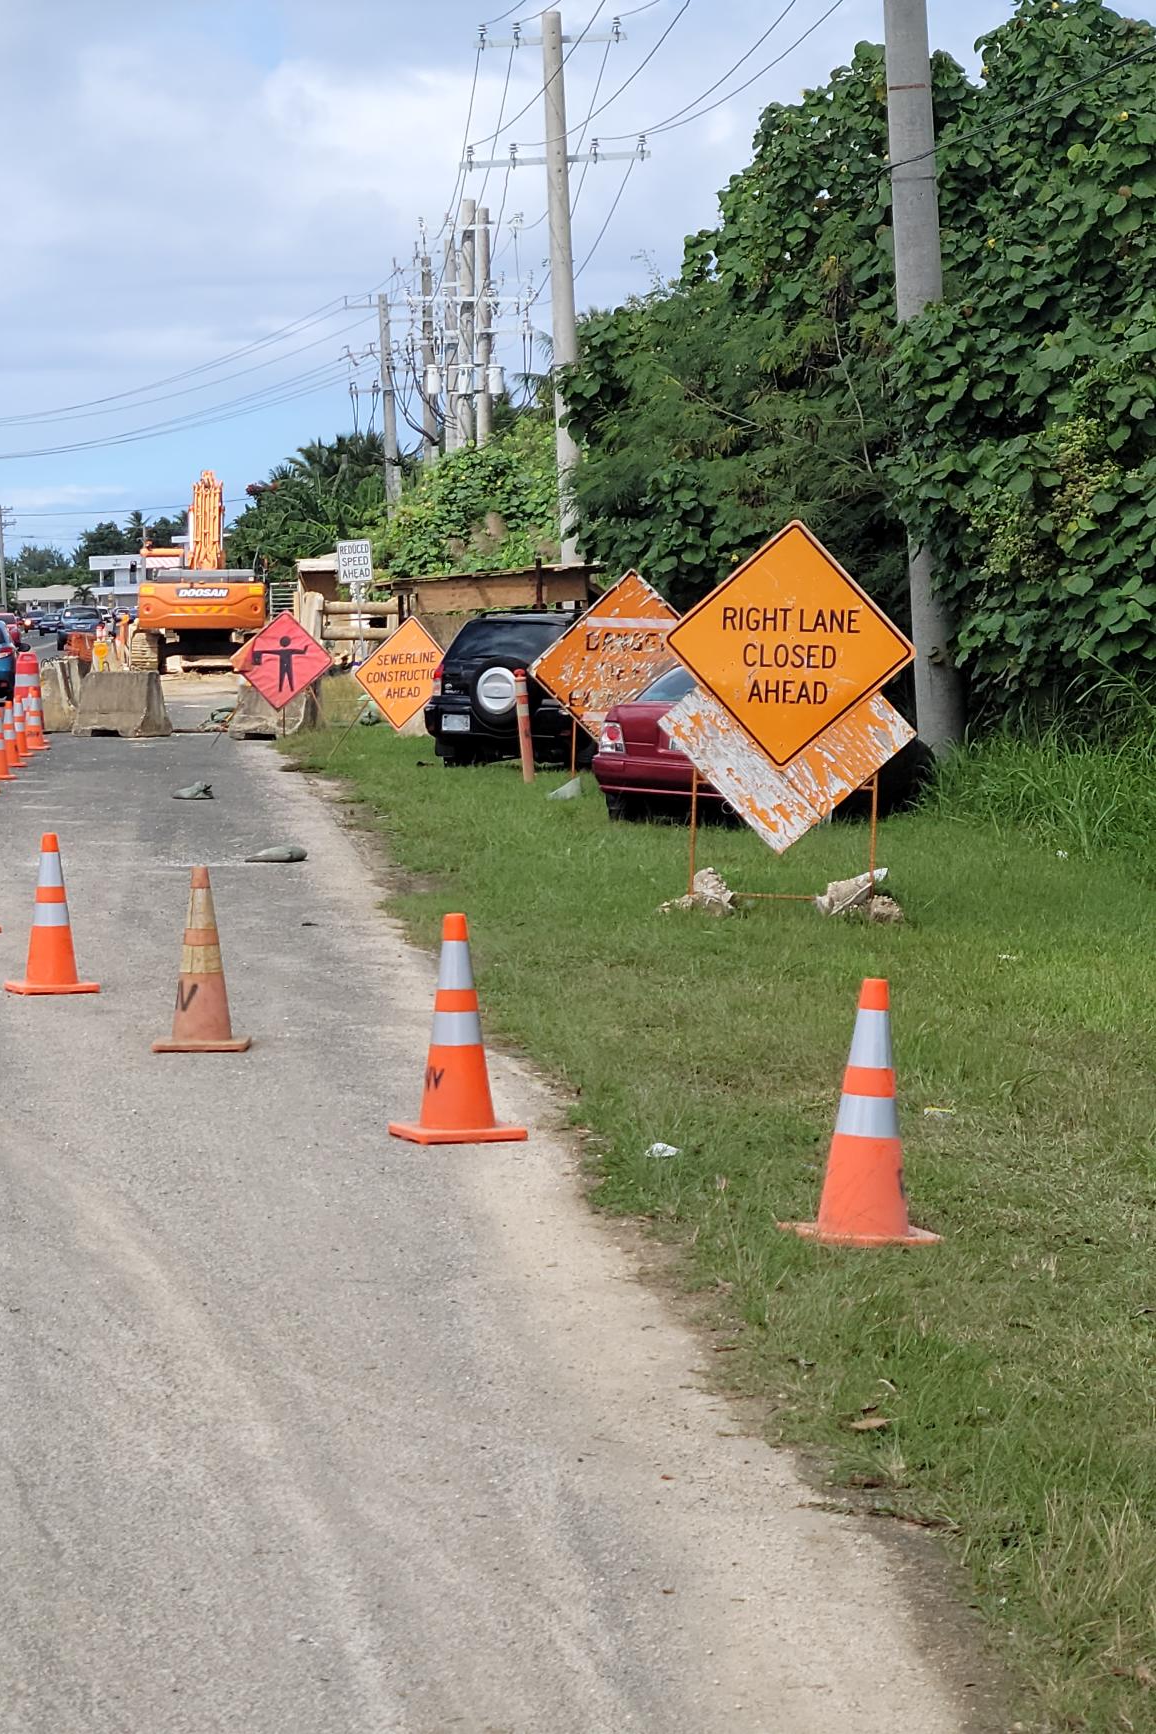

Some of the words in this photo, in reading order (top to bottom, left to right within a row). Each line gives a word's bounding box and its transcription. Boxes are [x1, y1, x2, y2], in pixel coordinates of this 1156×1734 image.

[339, 543, 369, 555] REDUCED
[342, 556, 369, 567] SPEED
[343, 568, 371, 579] AHEAD
[178, 588, 229, 597] DOOSAN
[722, 606, 793, 632] RIGHT
[799, 608, 861, 634] LANE
[376, 651, 437, 666] SEWERLINE
[743, 643, 837, 669] CLOSED
[366, 668, 436, 684] CONSTRUCTIO
[385, 686, 421, 699] AHEAD
[747, 679, 828, 705] AHEAD
